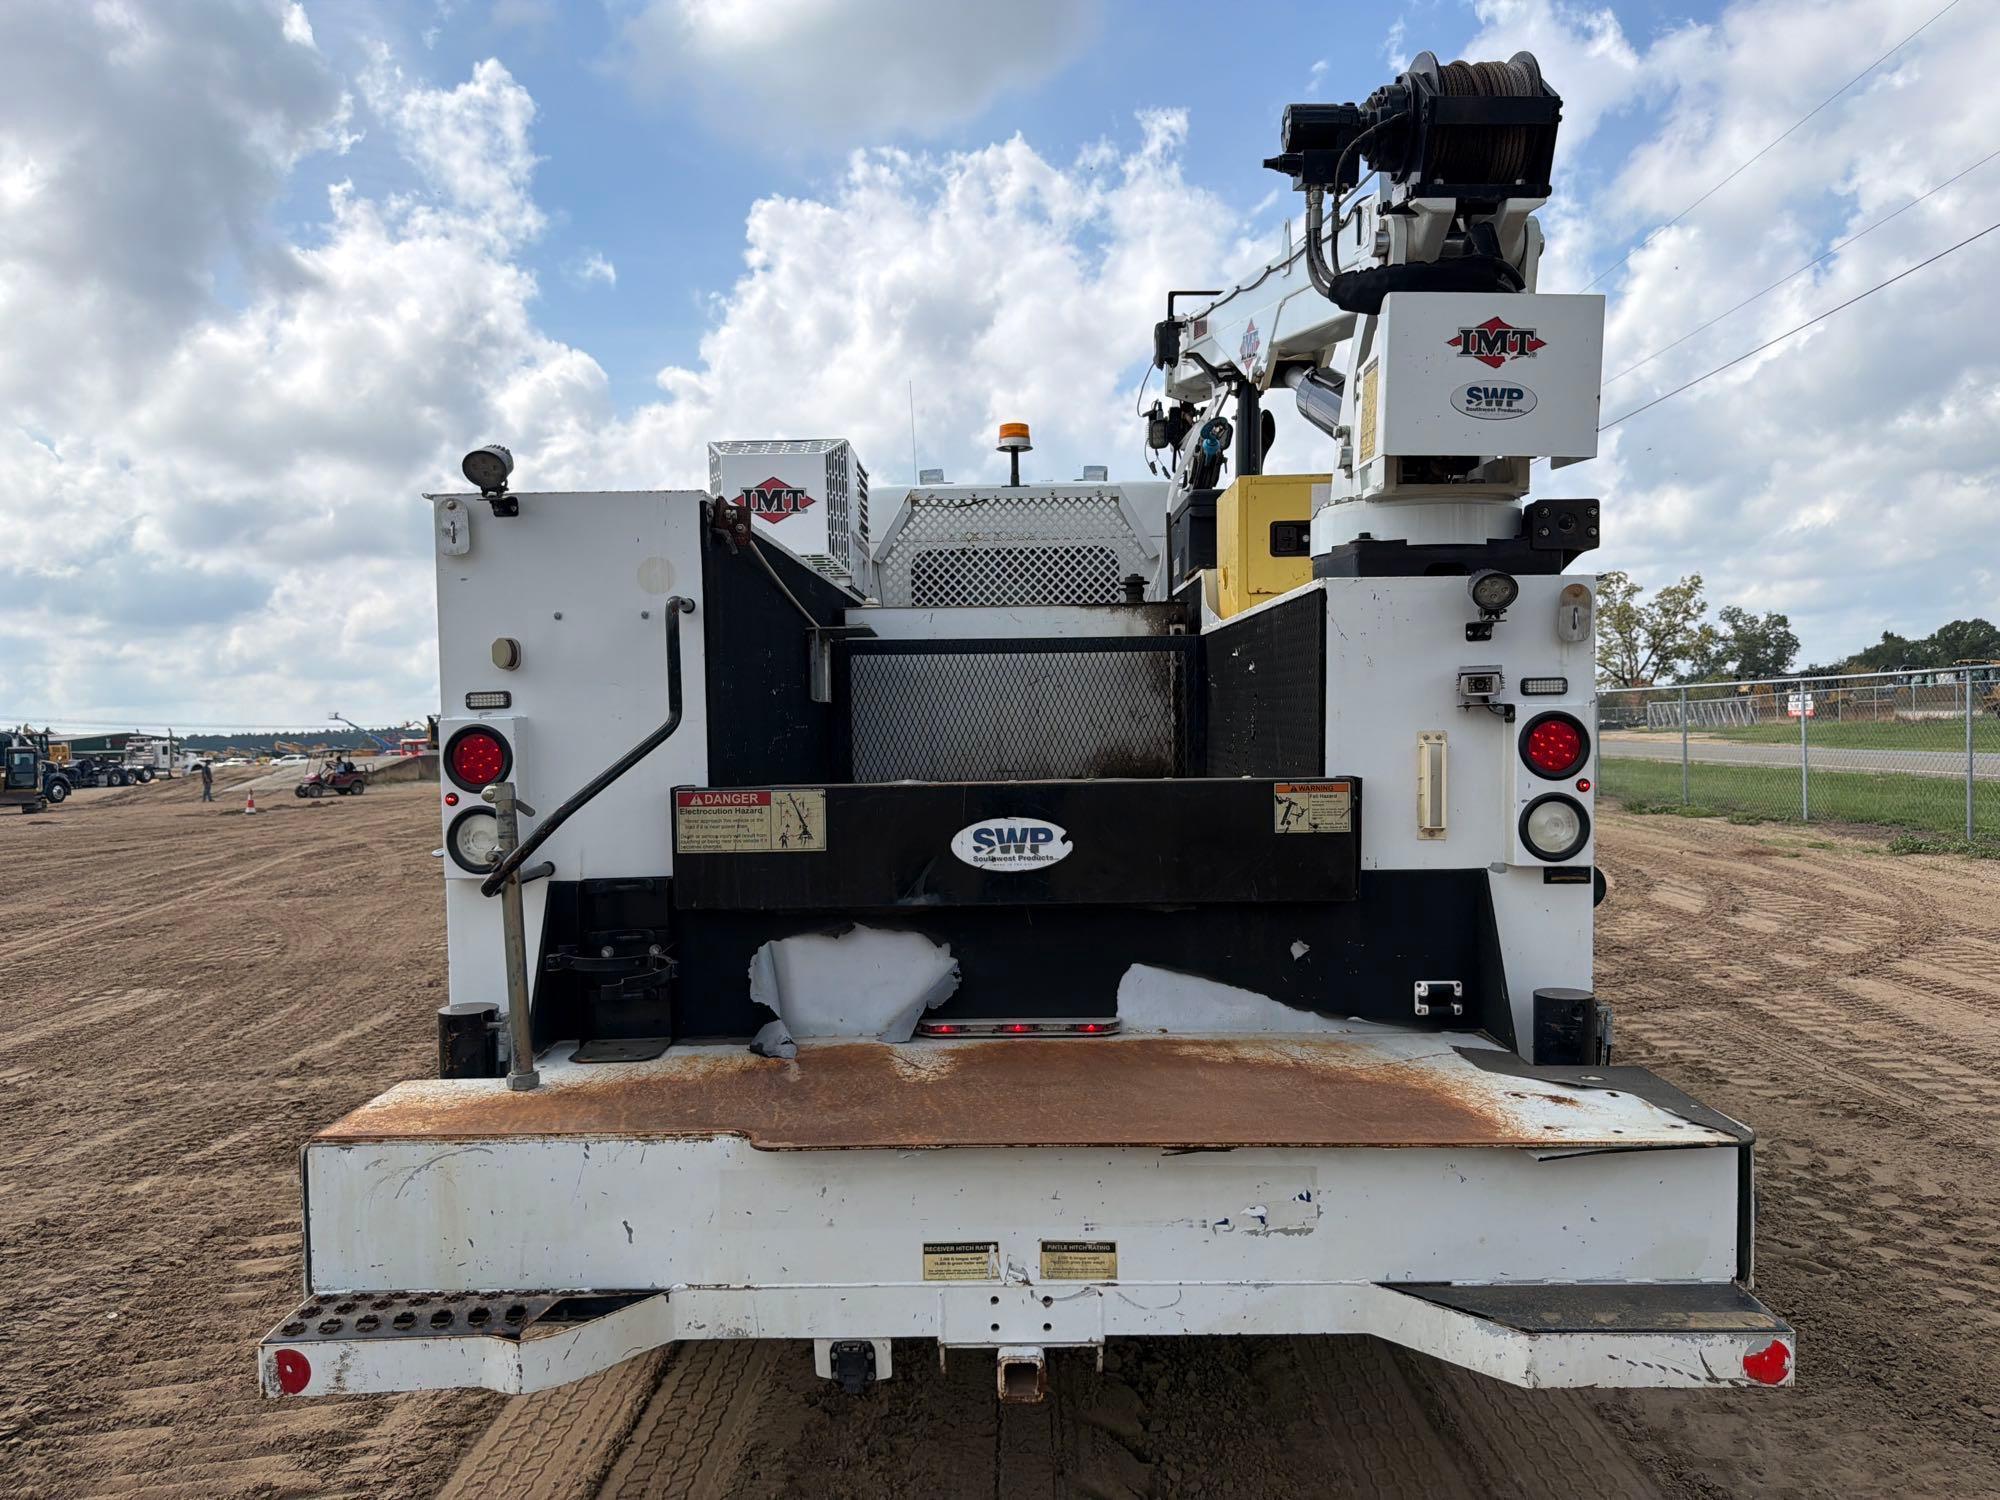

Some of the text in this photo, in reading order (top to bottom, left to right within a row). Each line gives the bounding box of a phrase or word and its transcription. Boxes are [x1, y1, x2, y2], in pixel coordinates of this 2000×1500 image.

[1459, 329, 1535, 356] IMT
[1466, 386, 1524, 408] SWP
[1497, 406, 1523, 414] Products
[743, 489, 804, 513] IMT
[704, 793, 758, 804] DANGER
[735, 807, 763, 815] Hazard
[972, 827, 1053, 855] SWP
